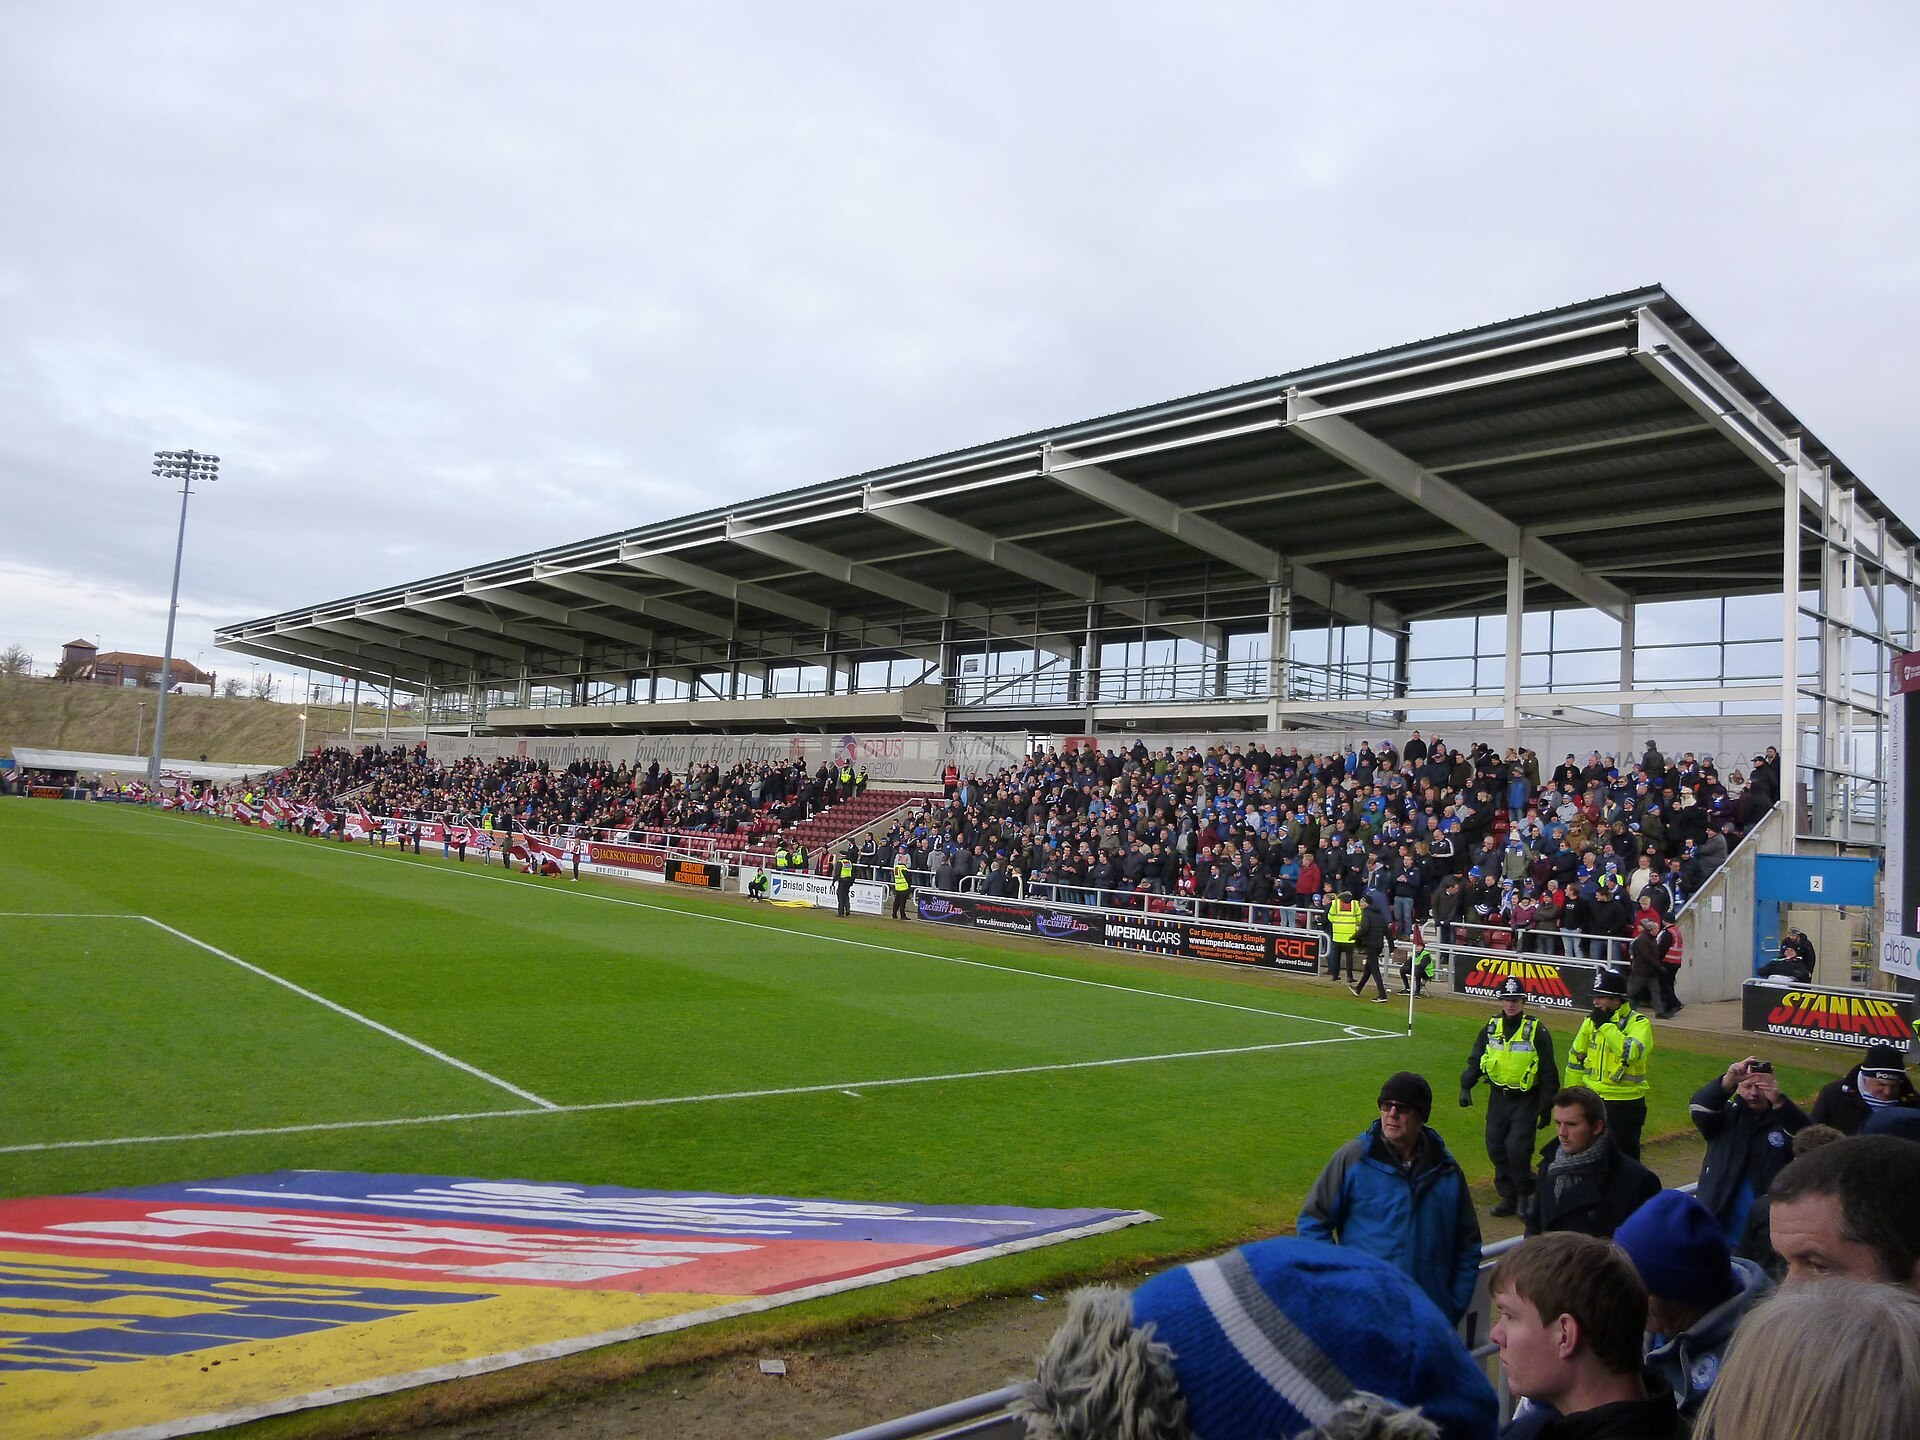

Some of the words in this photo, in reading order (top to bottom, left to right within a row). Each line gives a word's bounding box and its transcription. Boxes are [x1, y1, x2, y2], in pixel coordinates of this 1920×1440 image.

[635, 738, 686, 771] building
[710, 738, 733, 764] the
[737, 738, 782, 764] future
[863, 738, 902, 758] OPUS
[945, 735, 1010, 758] Sixfields
[932, 759, 981, 777] Tvel
[600, 848, 627, 862] JACKSON
[627, 851, 655, 865] GRUNDY
[680, 861, 705, 875] MERCURY
[674, 871, 710, 886] RECRUITMENT
[782, 879, 805, 891] Bristol
[806, 882, 827, 895] Street
[1813, 880, 1820, 889] 2
[1188, 936, 1266, 953] www.imperialcars.co.uk
[1189, 928, 1201, 936] Car
[1202, 929, 1223, 940] Buying
[1225, 932, 1242, 941] Made
[1243, 935, 1266, 944] Simple
[1884, 938, 1912, 966] dbfb
[1275, 957, 1297, 966] Approved
[1297, 959, 1313, 967] Dealer
[1465, 958, 1573, 998] STANAIR
[1464, 986, 1573, 1007] www.sir.co.uk
[1768, 991, 1912, 1039] STANAIR
